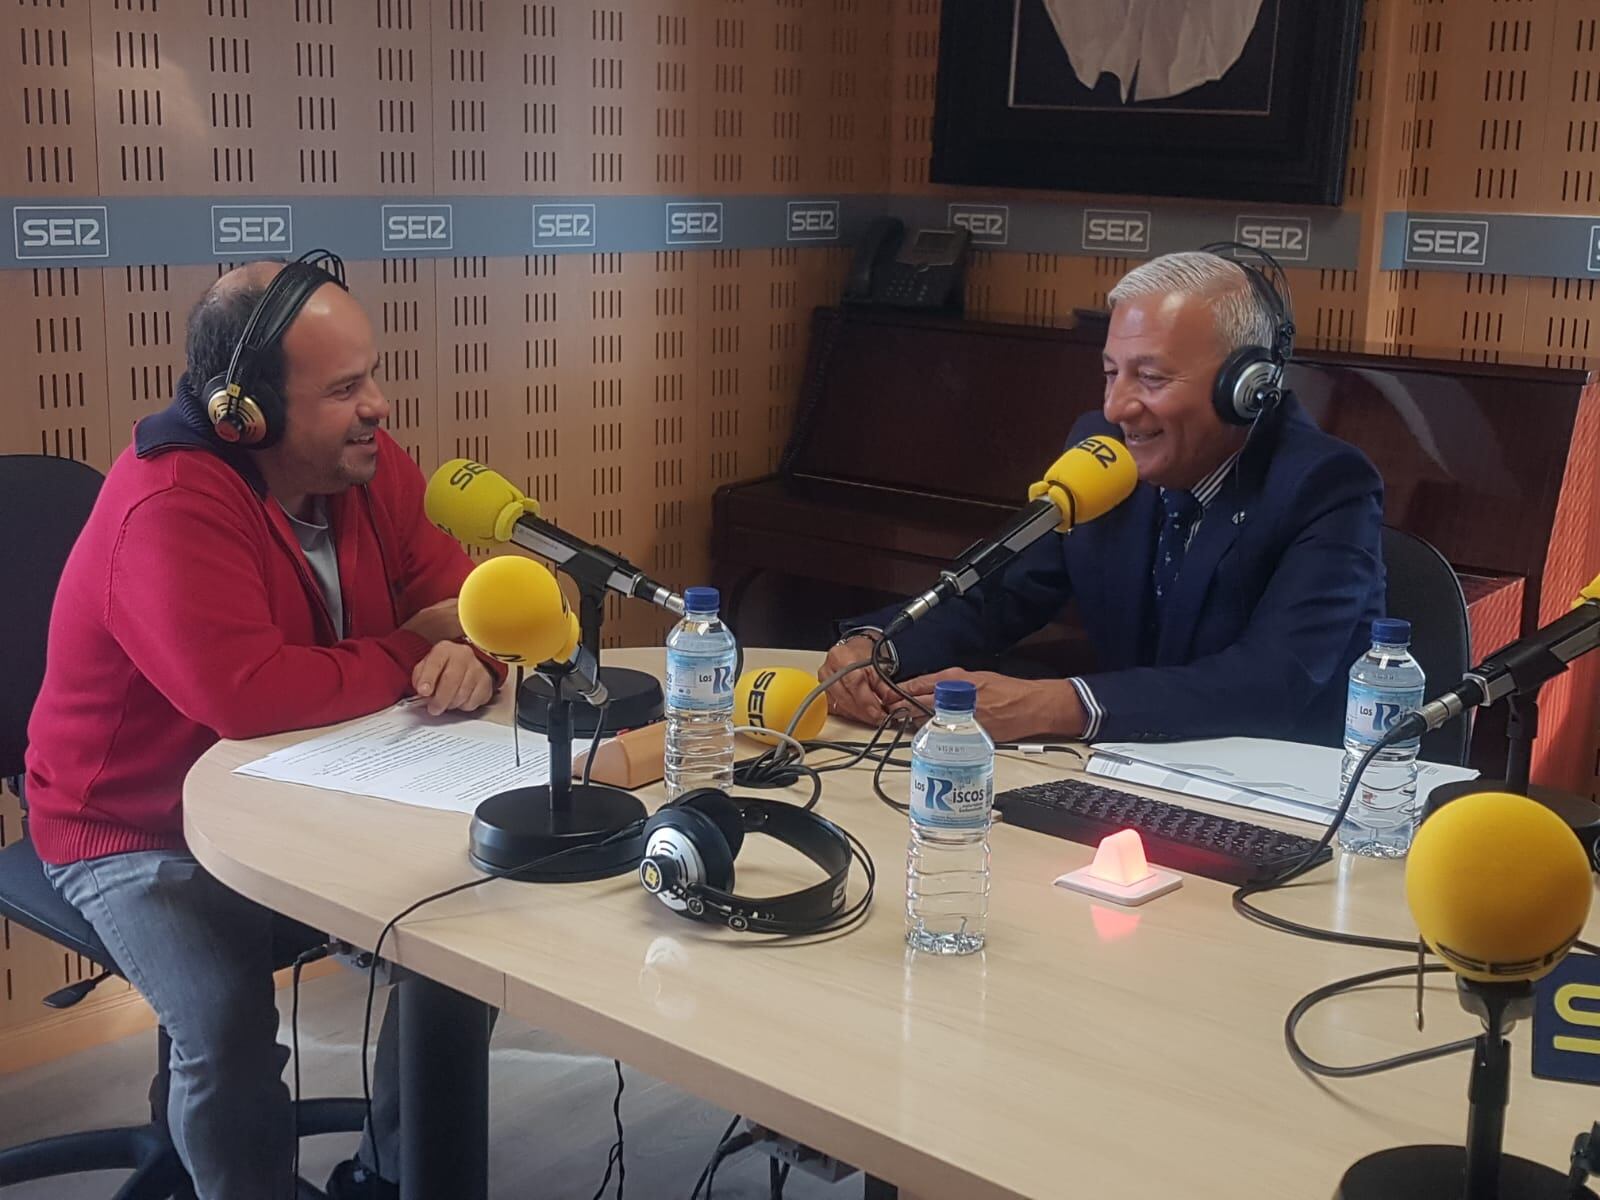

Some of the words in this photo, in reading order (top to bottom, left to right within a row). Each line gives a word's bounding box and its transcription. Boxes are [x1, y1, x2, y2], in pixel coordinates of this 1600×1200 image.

[23, 219, 101, 247] SER
[219, 217, 287, 243] SER
[388, 216, 447, 240] SER
[538, 214, 591, 238] SER
[671, 213, 719, 235] SER
[791, 211, 834, 232] SER
[953, 213, 1003, 235] SER
[1088, 219, 1144, 242] SER
[1241, 226, 1303, 250] SER
[1413, 230, 1480, 255] SER
[450, 462, 489, 491] SE
[925, 776, 985, 812] Riscos
